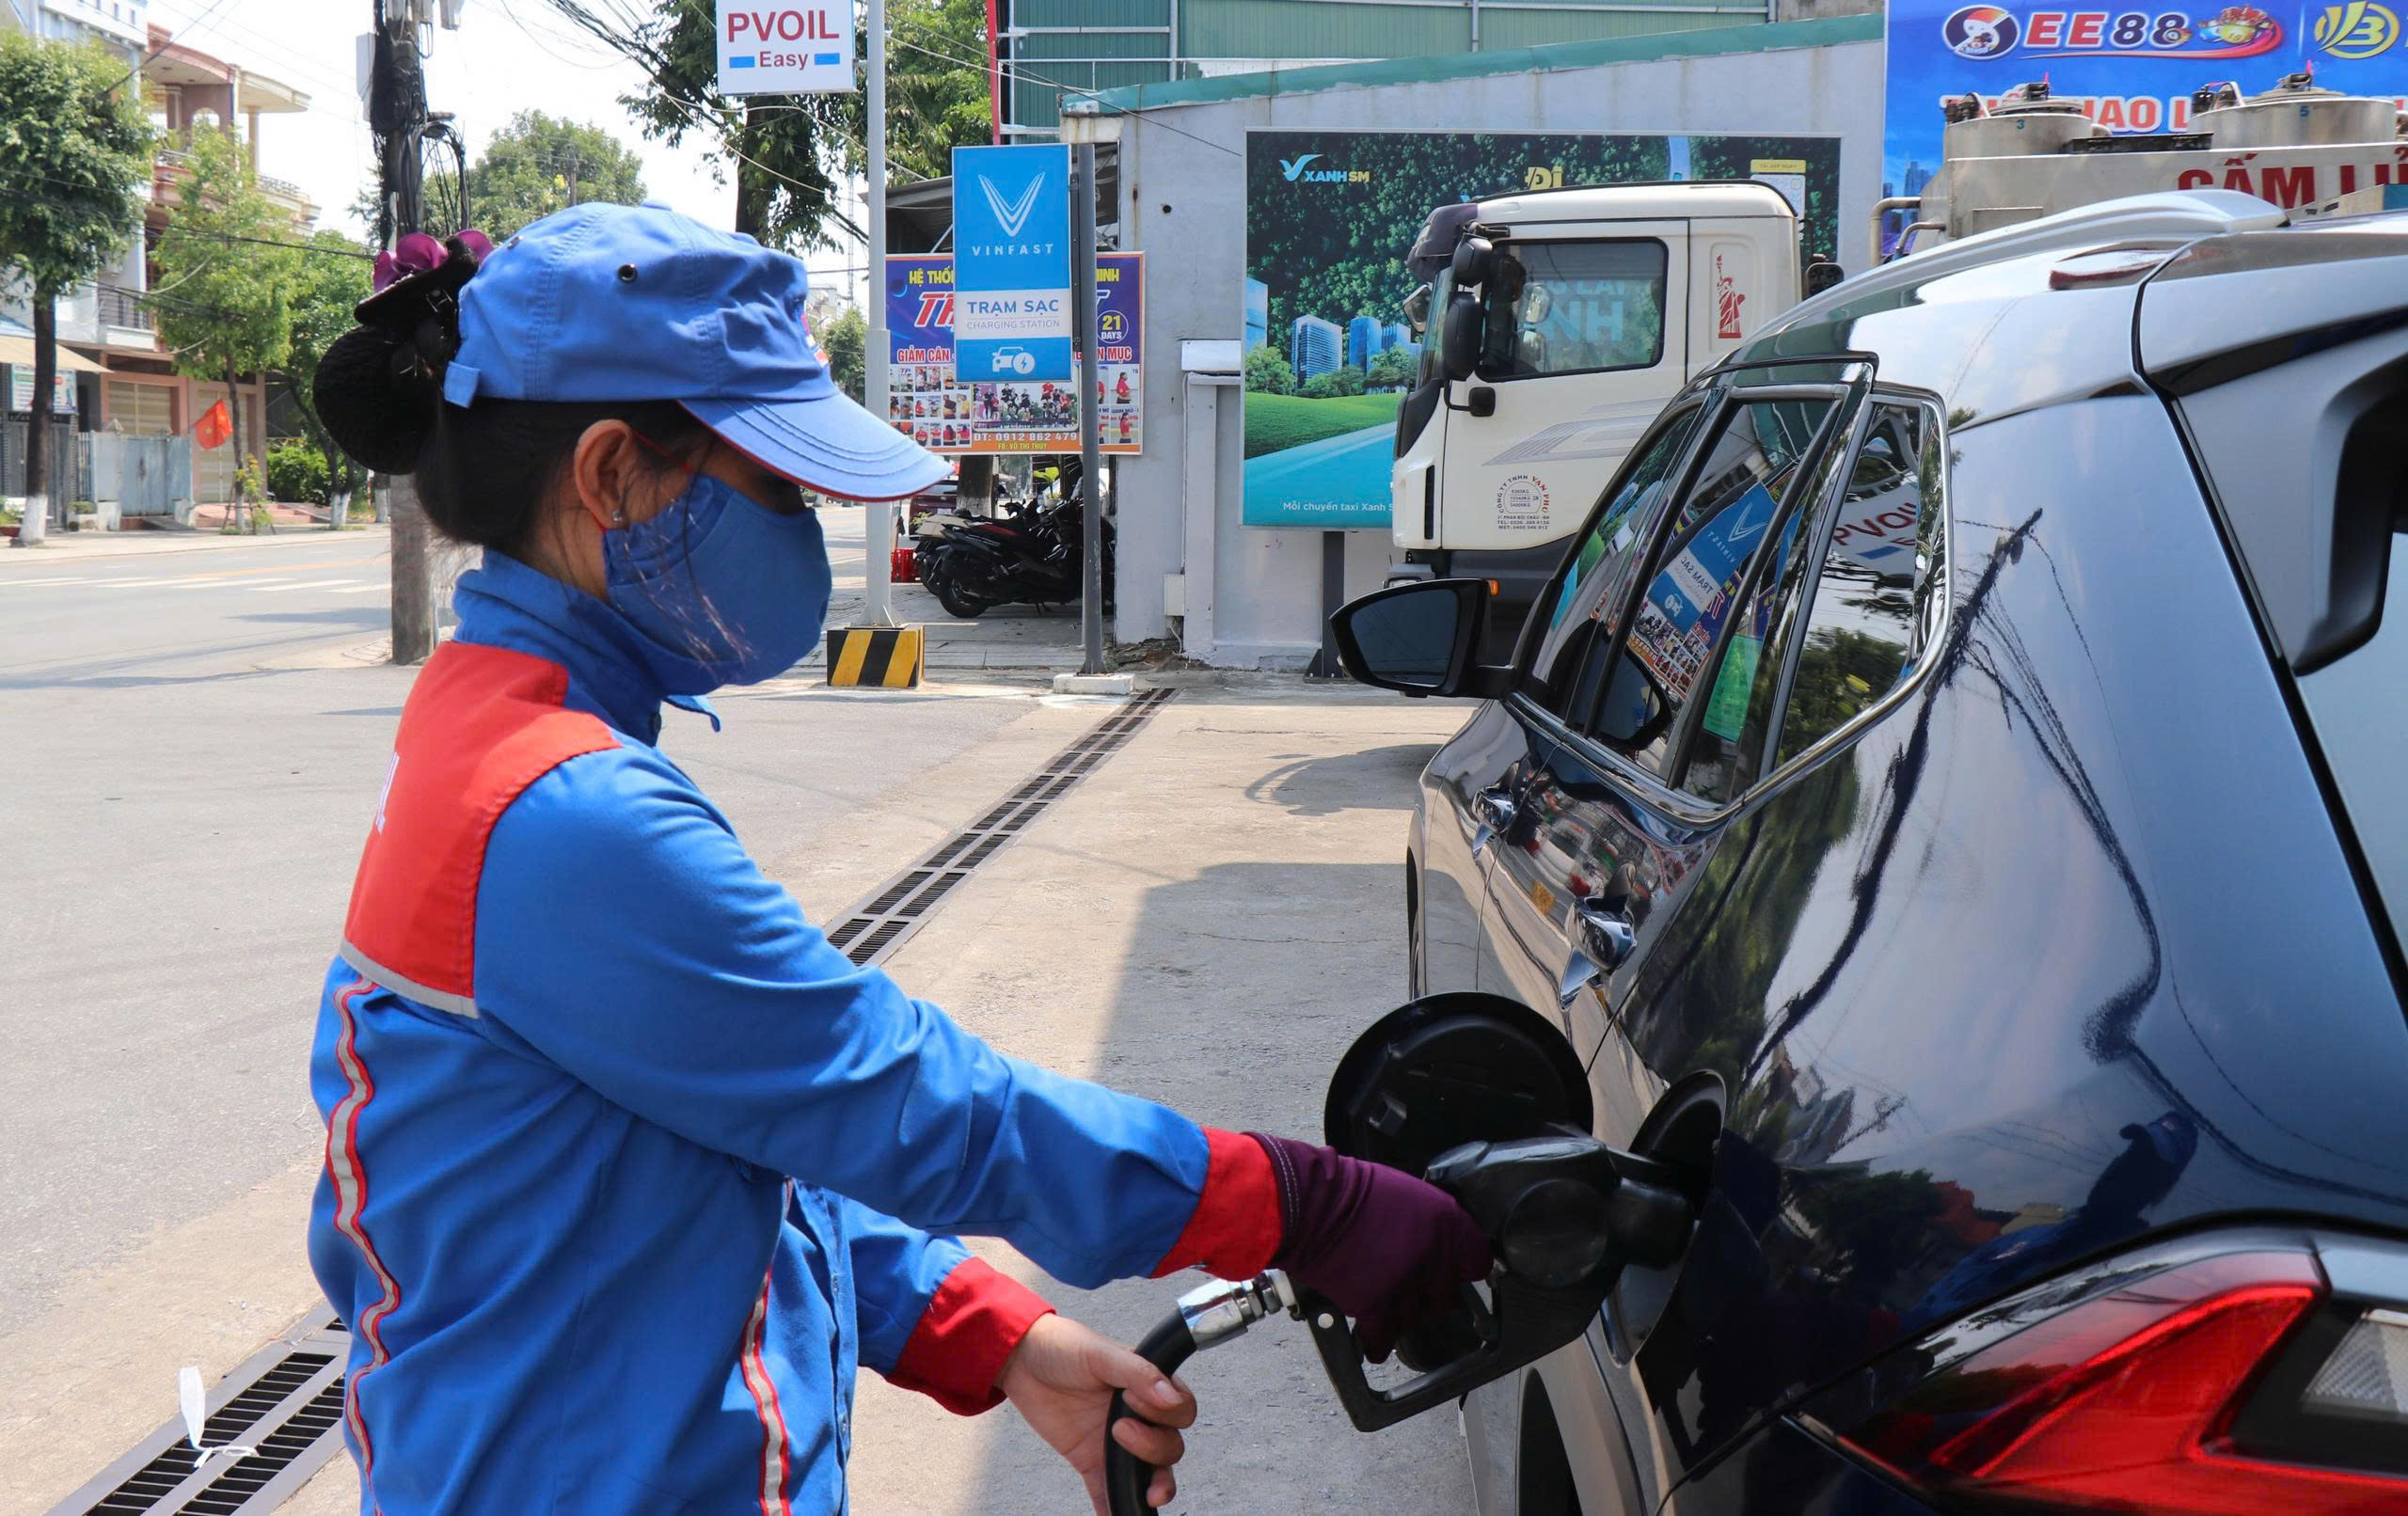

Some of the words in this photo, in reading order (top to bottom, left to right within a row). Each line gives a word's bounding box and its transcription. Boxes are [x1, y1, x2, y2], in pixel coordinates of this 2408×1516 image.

[727, 9, 840, 43] PVOIL
[2024, 11, 2189, 48] EE88
[759, 51, 809, 71] Easy
[2299, 105, 2310, 118] 5
[2017, 119, 2025, 130] 3
[972, 244, 1054, 257] VINFAST
[909, 267, 925, 288] HỆ
[967, 300, 1017, 317] TRẠM
[1023, 299, 1060, 316] SẠC
[966, 321, 1017, 330] CHARGING
[1020, 319, 1060, 329] STATION
[1101, 315, 1121, 331] 21
[1101, 331, 1122, 340] DAYS
[897, 344, 926, 363] GIẢM
[927, 345, 951, 363] CÂN
[1107, 346, 1133, 364] MỤC
[995, 433, 1025, 441] 0912
[1029, 433, 1052, 441] 862
[1054, 433, 1078, 441] 479
[1340, 502, 1358, 511] taxi
[1361, 502, 1386, 512] Xanh
